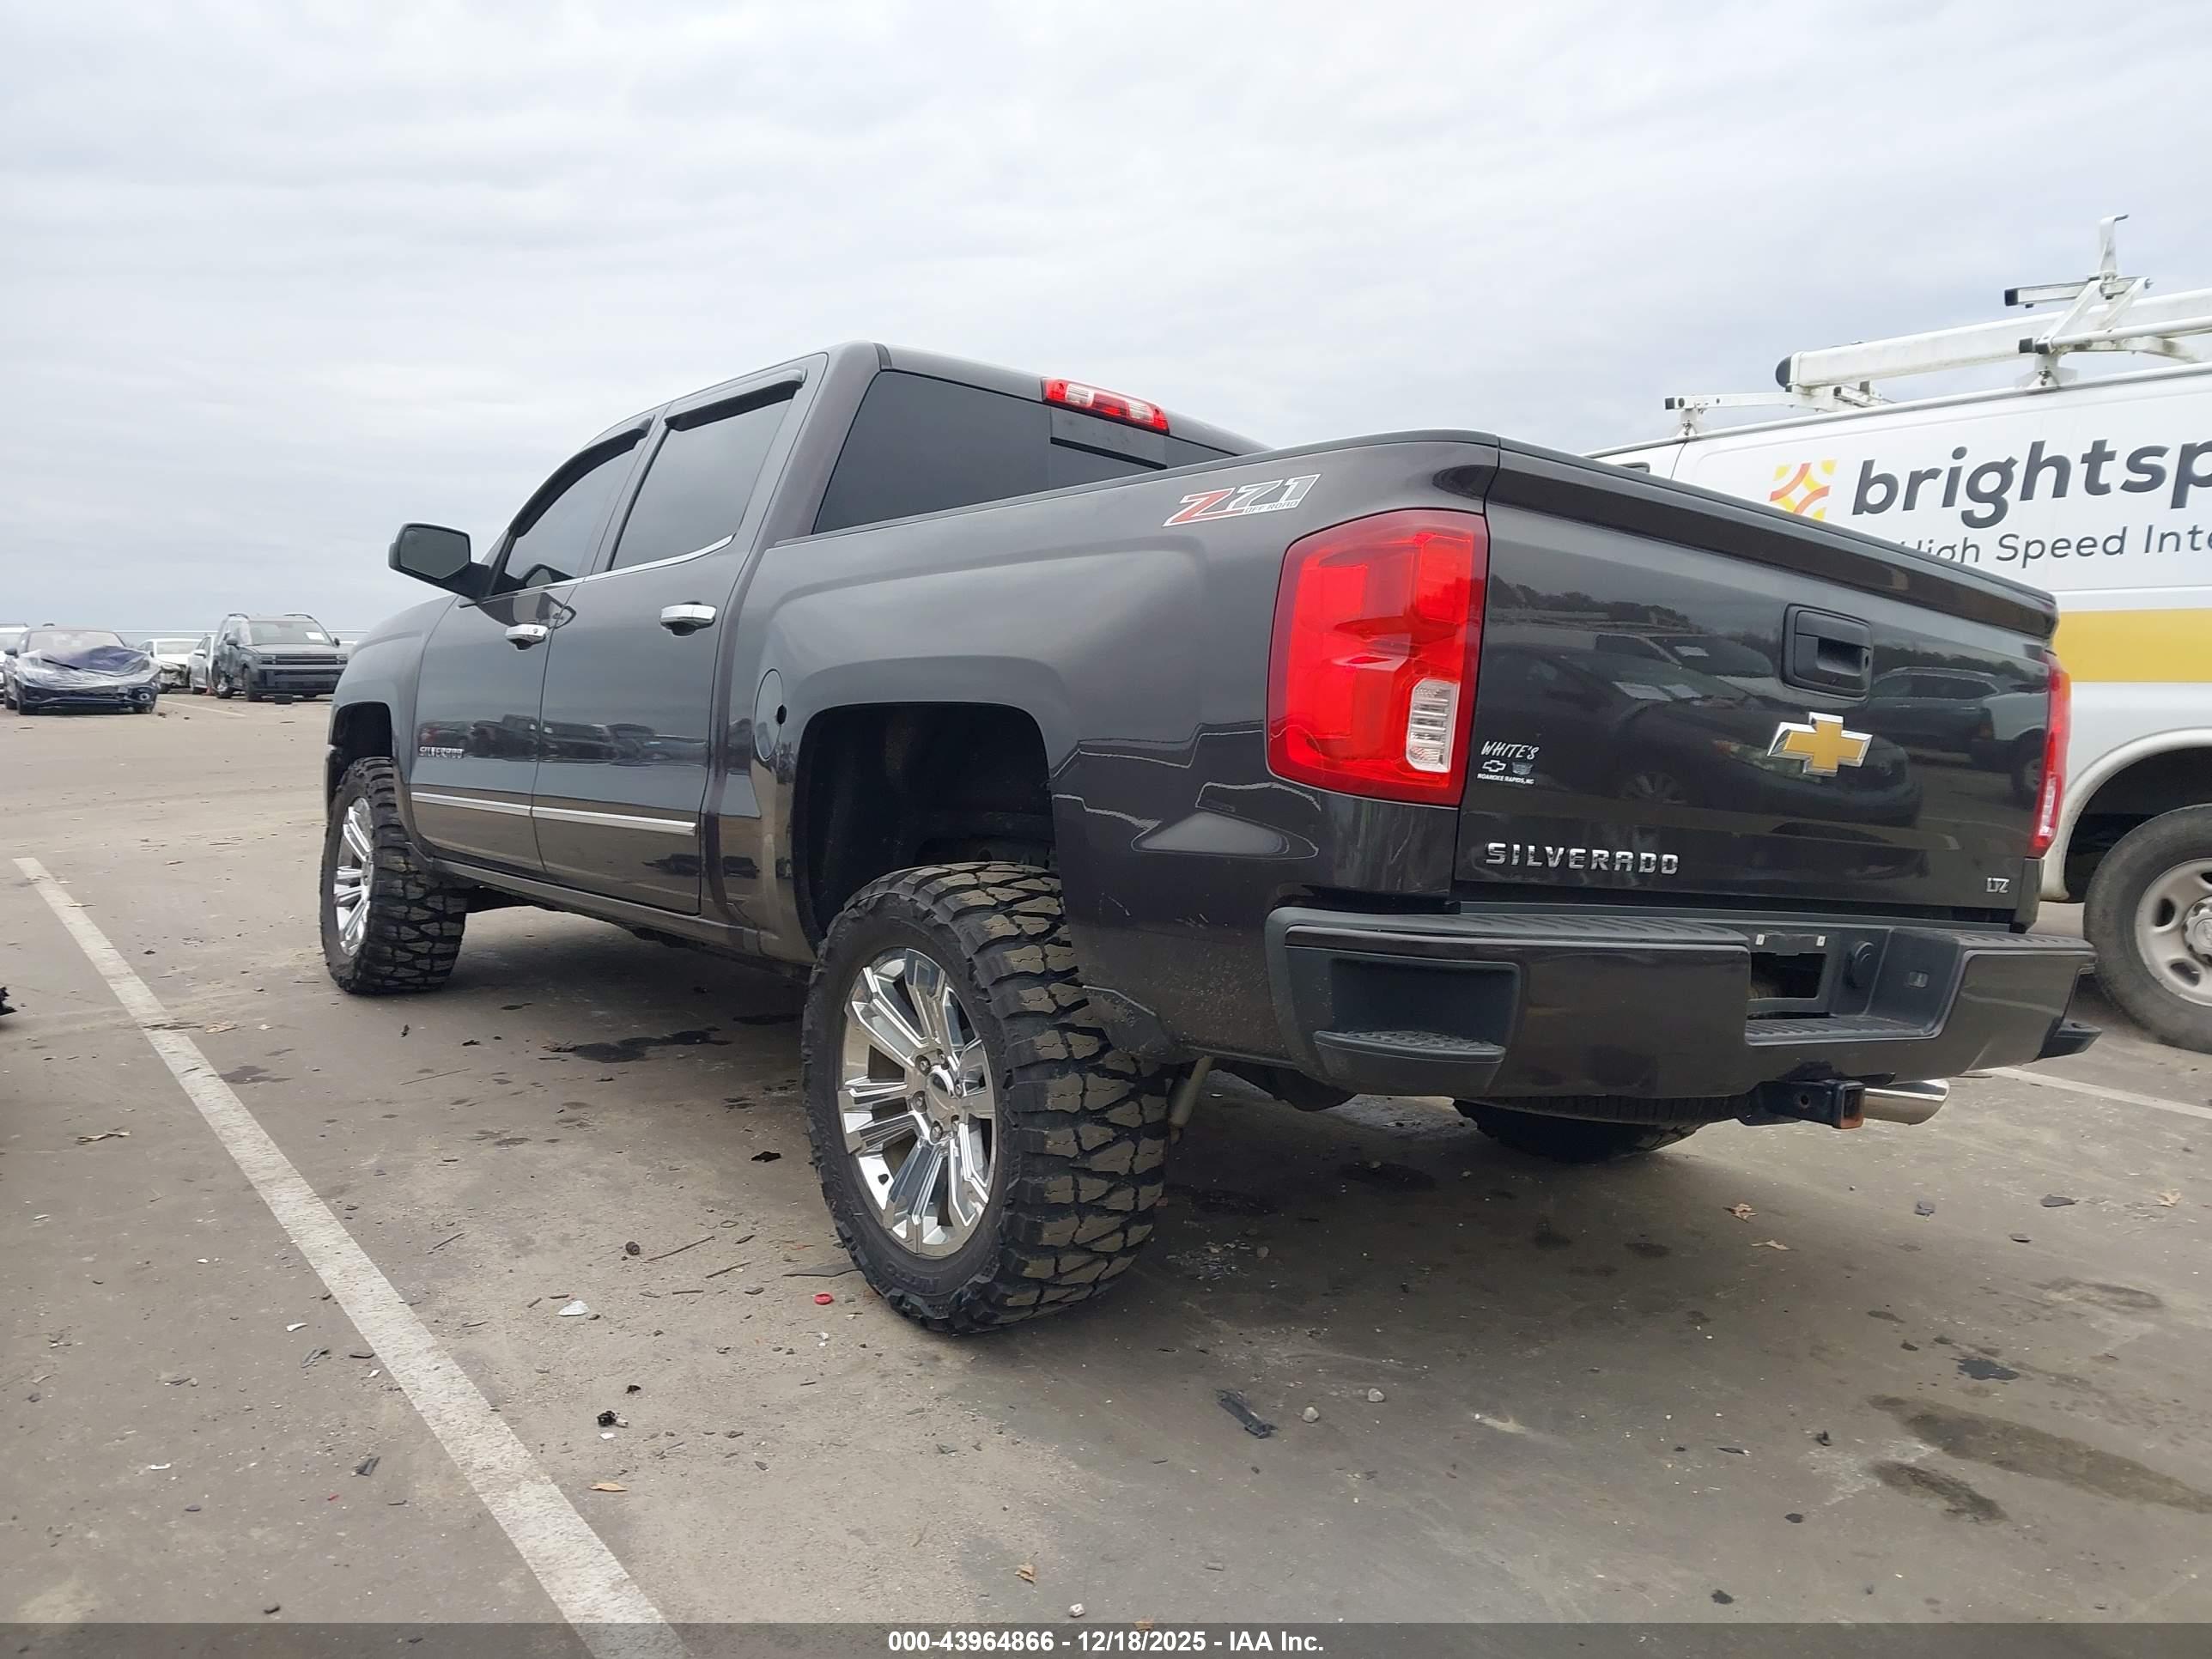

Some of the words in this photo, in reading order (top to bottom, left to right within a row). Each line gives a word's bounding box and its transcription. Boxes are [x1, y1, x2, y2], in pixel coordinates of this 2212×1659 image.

[1162, 473, 1322, 527] Z71
[1244, 506, 1267, 514] OFF
[1268, 500, 1298, 510] ROAD
[1996, 526, 2129, 568] Speed
[2144, 525, 2212, 554] Int
[1480, 740, 1540, 760] WHITE'S
[1486, 842, 1680, 875] SILVERADO
[1986, 877, 2010, 893] LTZ
